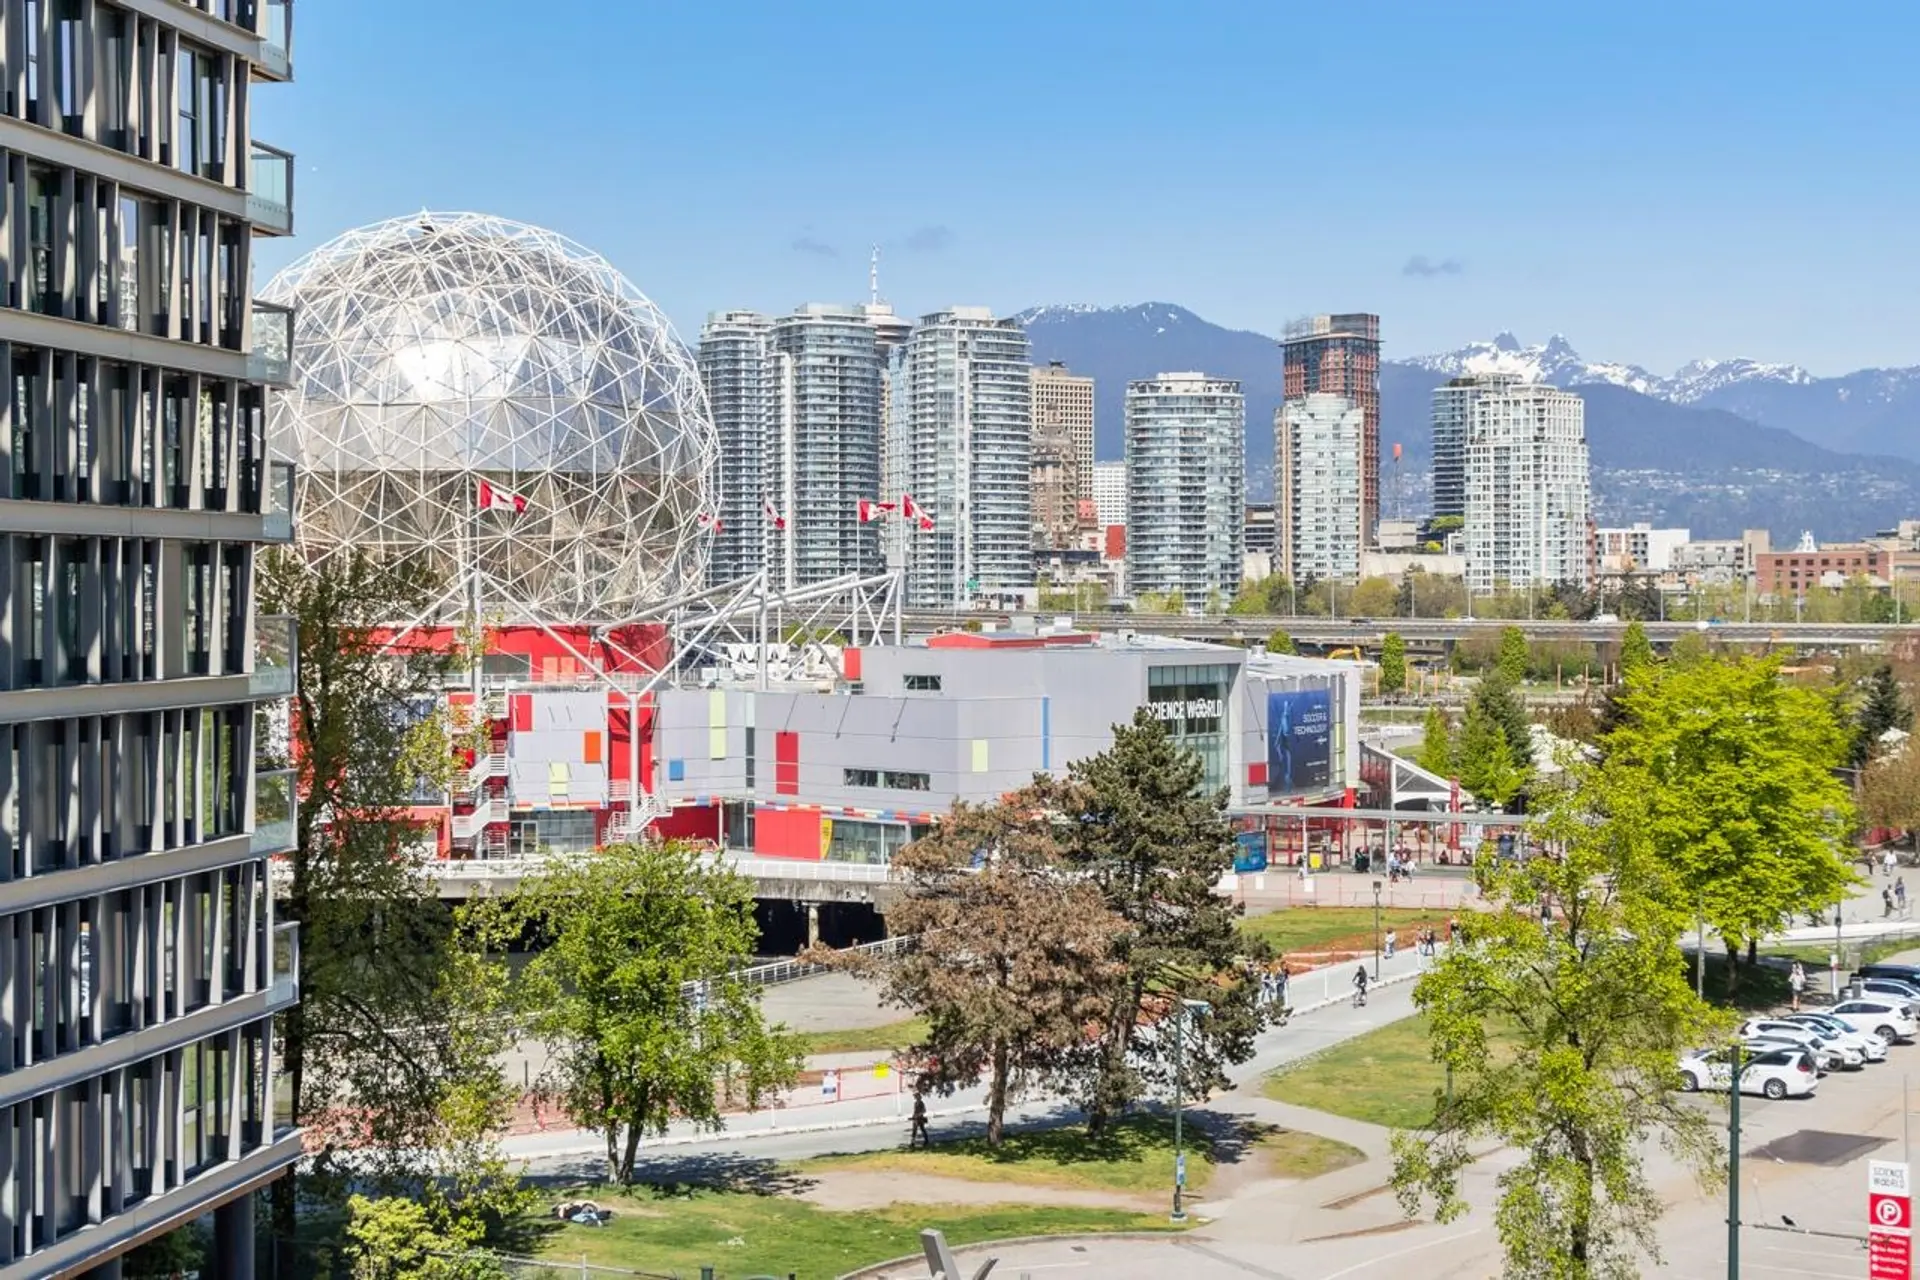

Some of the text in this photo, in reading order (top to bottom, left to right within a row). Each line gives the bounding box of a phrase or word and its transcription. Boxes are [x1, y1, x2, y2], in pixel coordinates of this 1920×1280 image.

[1145, 698, 1222, 720] SCIENCE WORLD
[1883, 1204, 1897, 1220] P
